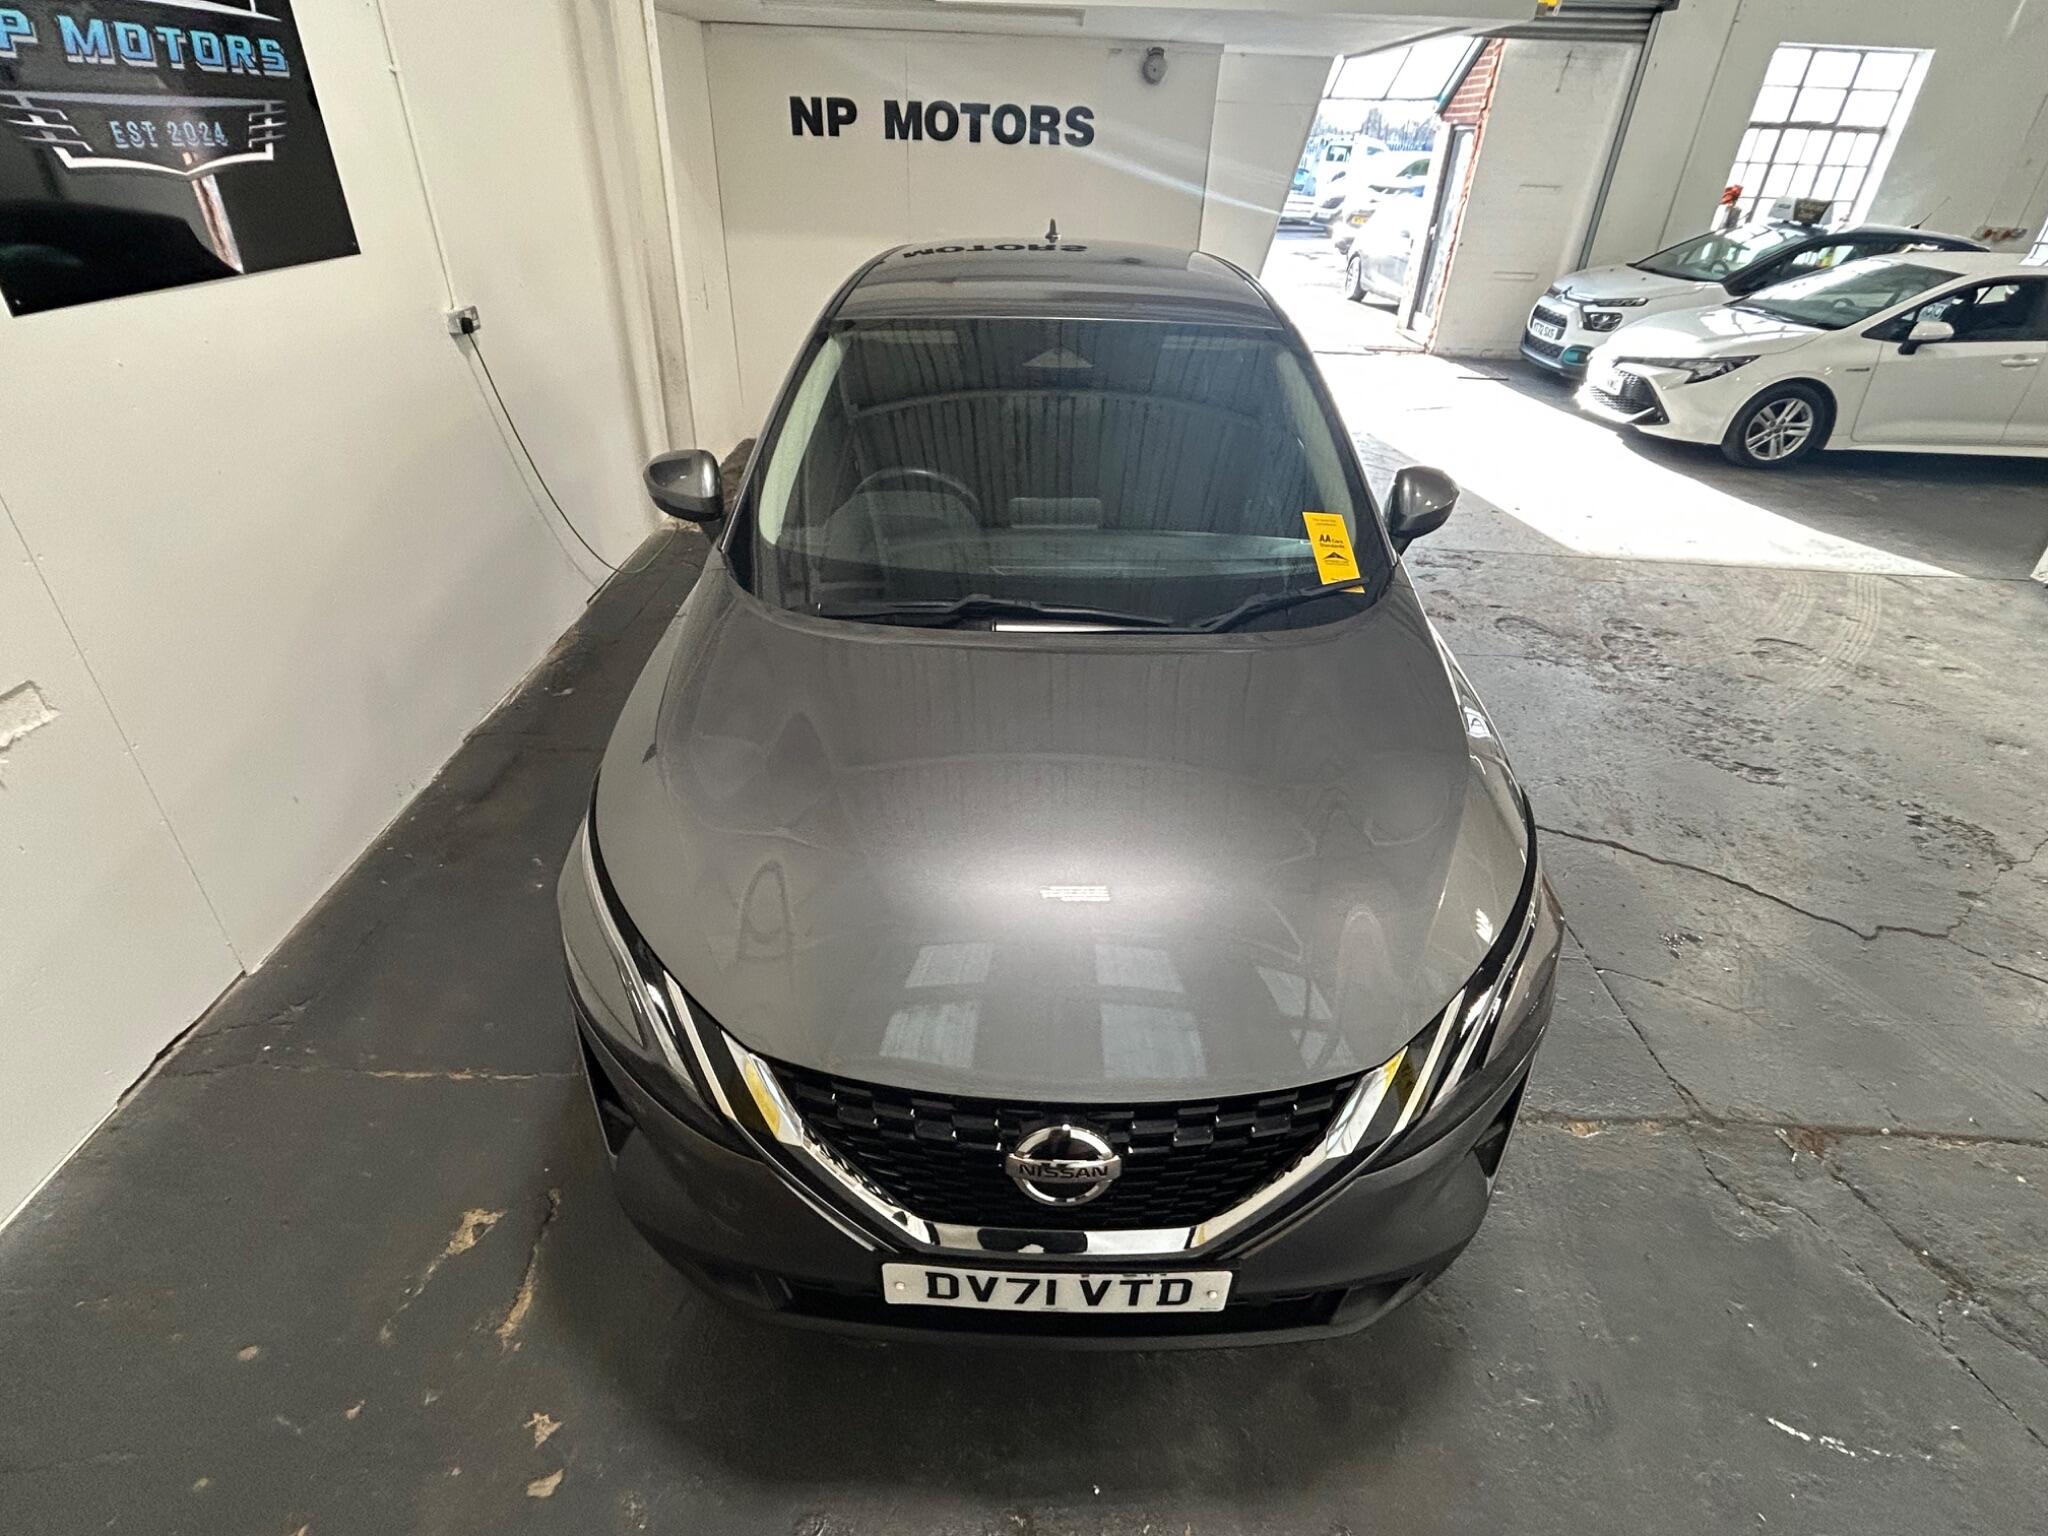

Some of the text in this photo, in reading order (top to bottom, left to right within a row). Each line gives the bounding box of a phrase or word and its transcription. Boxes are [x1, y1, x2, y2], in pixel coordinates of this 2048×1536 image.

[57, 15, 290, 77] MOTORS
[110, 121, 228, 148] EST 2024
[789, 96, 1095, 147] NP MOTORS
[1019, 1164, 1108, 1179] NISSAN
[925, 1271, 1193, 1307] DV71 VTD
